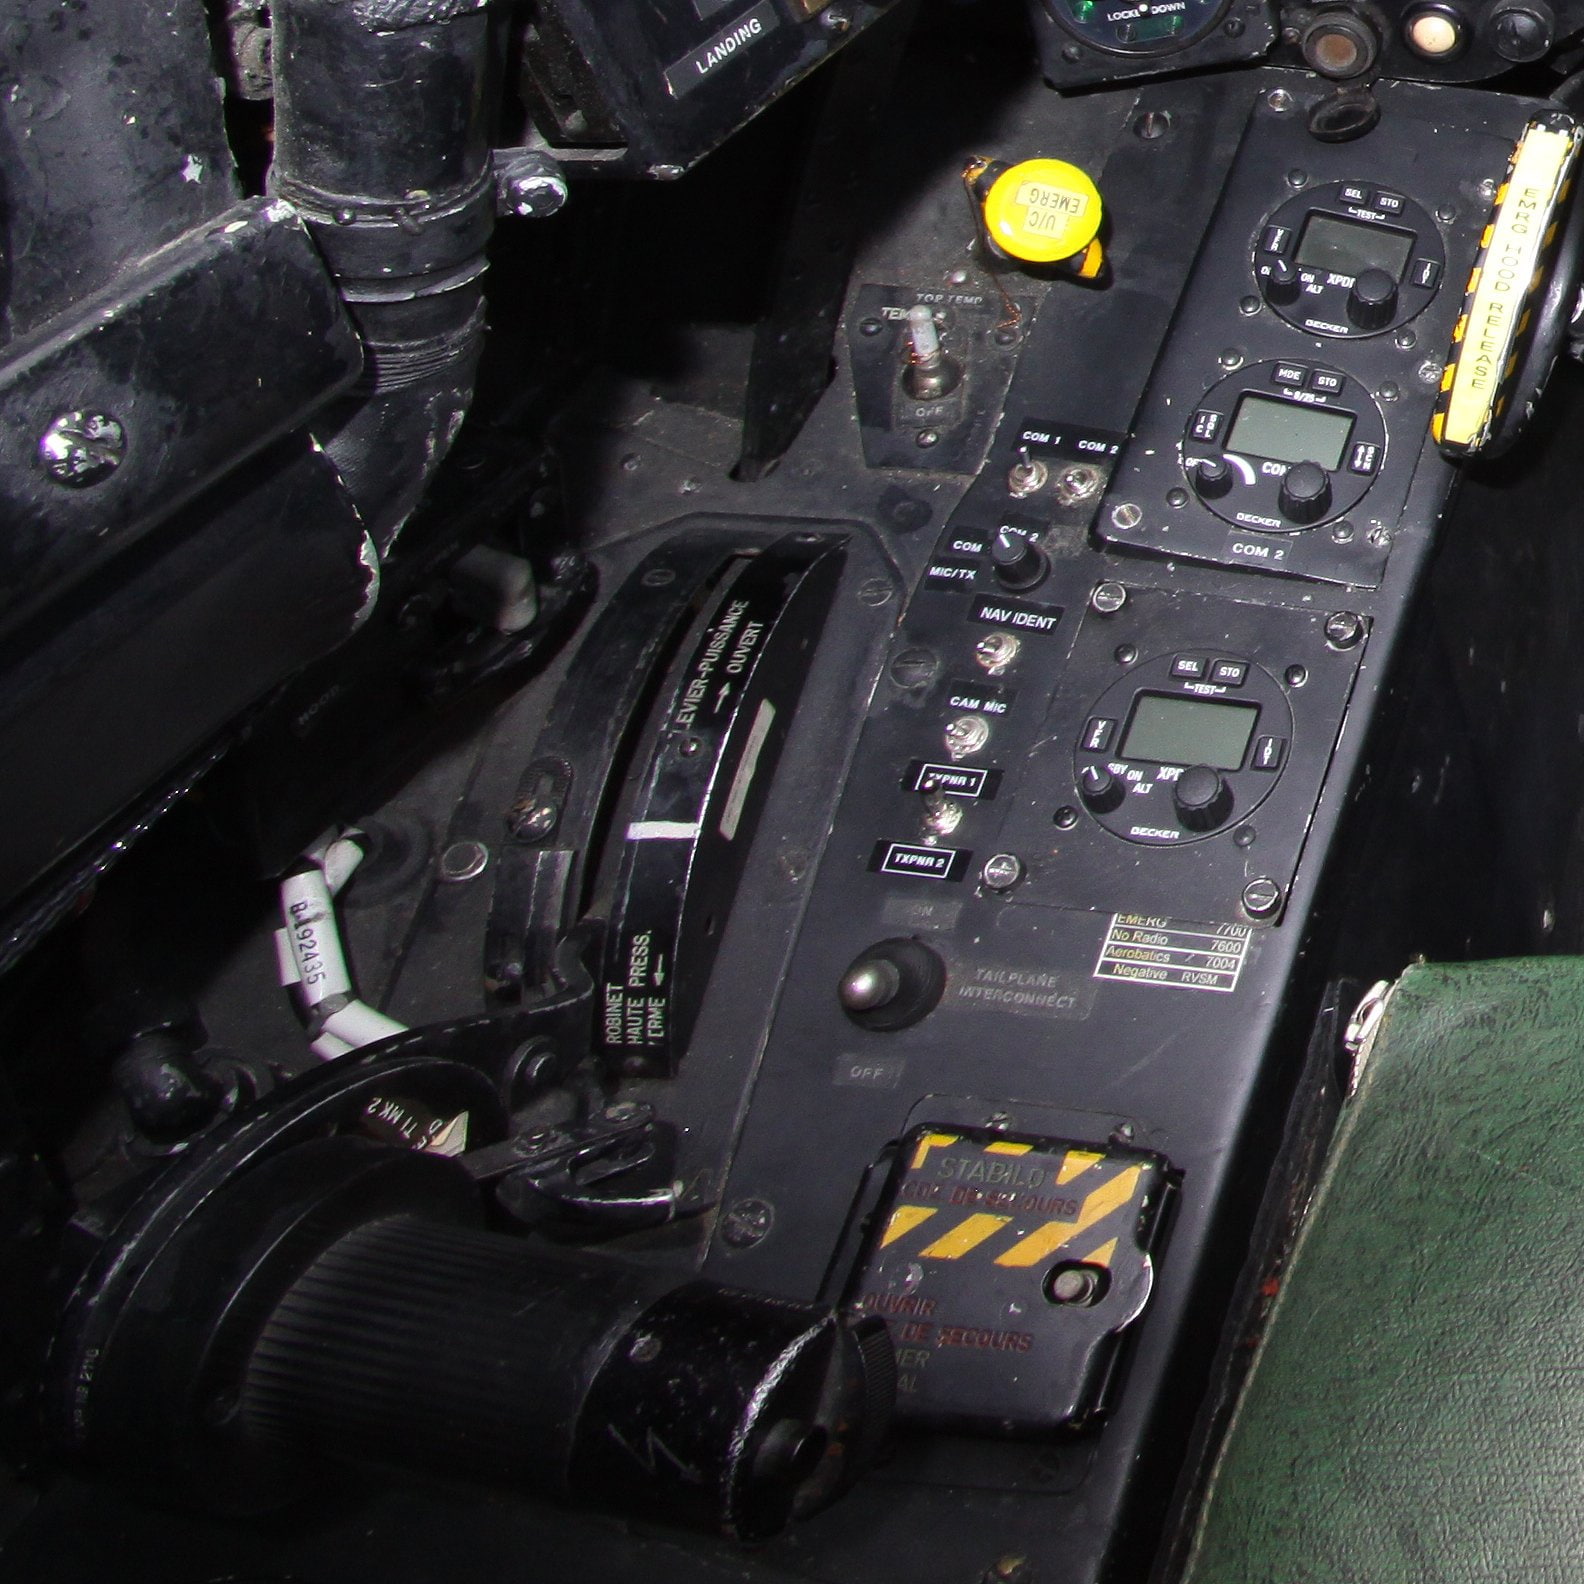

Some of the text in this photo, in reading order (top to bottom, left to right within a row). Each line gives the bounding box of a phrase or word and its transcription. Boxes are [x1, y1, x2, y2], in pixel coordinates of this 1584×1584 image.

[696, 17, 763, 75] LANDING
[1028, 187, 1086, 211] EMERG
[1022, 429, 1062, 445] COM 1
[1232, 542, 1285, 561] COM 2
[928, 565, 977, 581] MIC/TX
[979, 606, 1058, 632] NAV IDENT
[726, 620, 765, 675] OUVERT
[949, 694, 1008, 714] CAM MIC
[1130, 932, 1169, 946] Radio
[1209, 939, 1243, 954] 7600
[1112, 963, 1219, 986] Negative RVSM
[605, 981, 626, 1045] ROBINET
